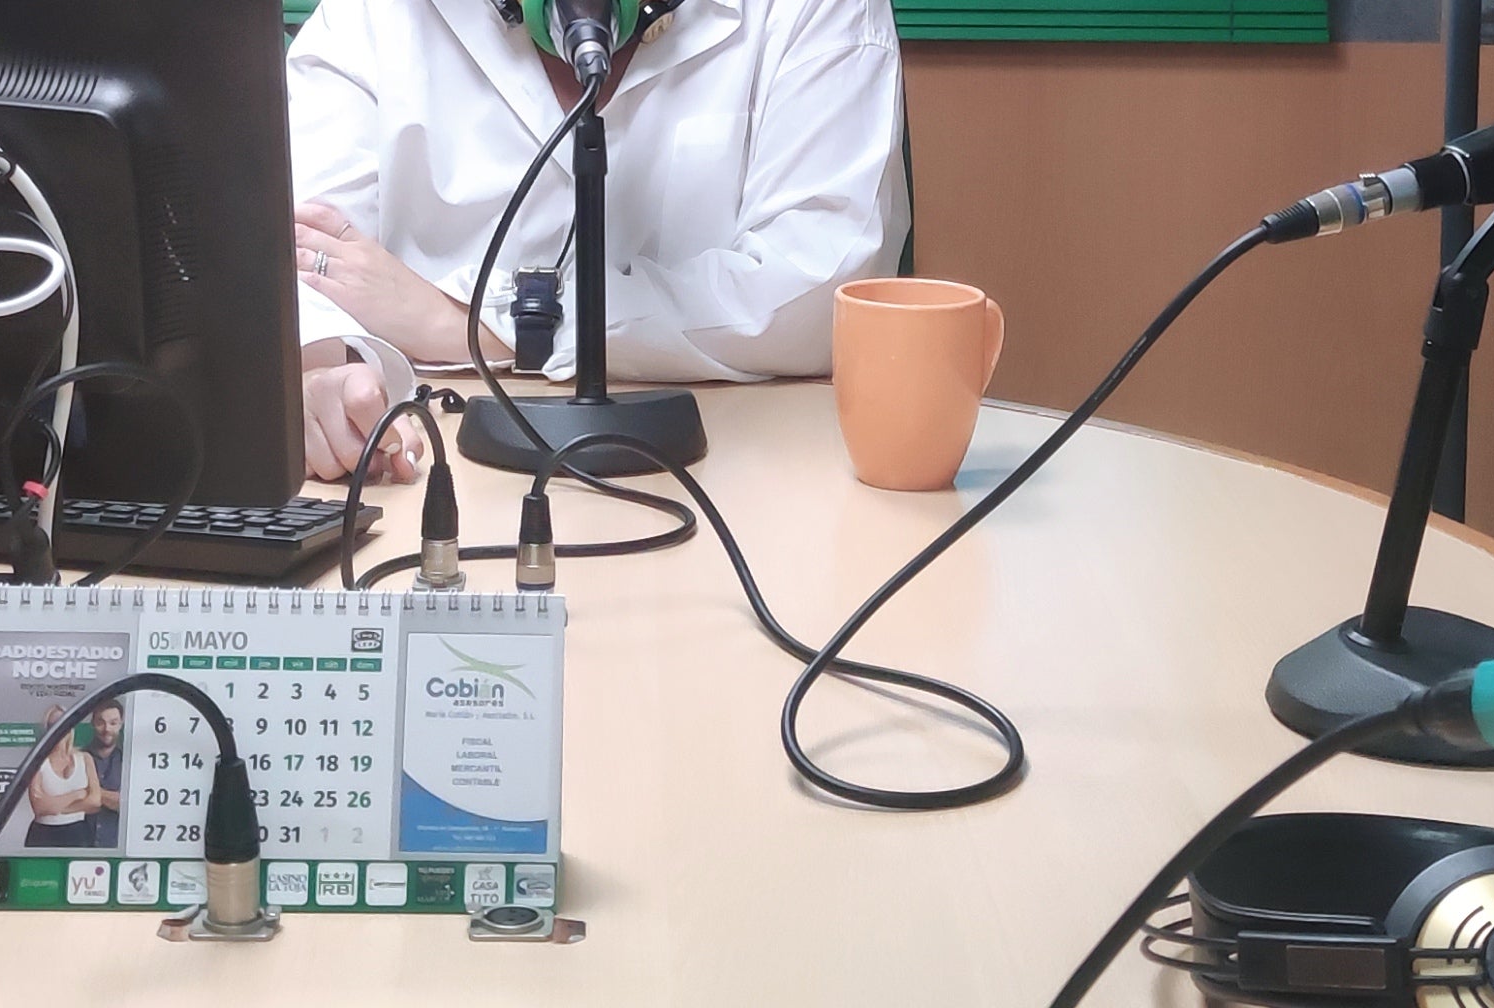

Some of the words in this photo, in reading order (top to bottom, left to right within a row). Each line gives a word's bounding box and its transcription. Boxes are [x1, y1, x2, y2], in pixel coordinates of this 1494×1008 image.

[184, 631, 249, 650] MAYO
[12, 660, 99, 680] NOCHE
[225, 683, 234, 698] 1
[257, 683, 269, 699] 2
[291, 683, 303, 700] 3
[324, 684, 337, 701] 4
[358, 684, 370, 701] 5
[426, 676, 505, 699] Cobián
[154, 716, 167, 733] 6
[189, 717, 200, 734] 7
[256, 717, 268, 734] 9
[284, 718, 307, 735] 10
[319, 719, 339, 736] 11
[352, 720, 374, 736] 12
[148, 752, 170, 769] 13
[181, 753, 204, 770] 14
[249, 754, 271, 770] 16
[284, 754, 305, 771] 17
[315, 755, 339, 772] 18
[350, 755, 373, 772] 19
[144, 788, 169, 805] 20
[179, 789, 201, 806] 21
[280, 790, 304, 807] 24
[313, 791, 338, 808] 25
[347, 791, 372, 808] 26
[143, 824, 167, 842] 27
[176, 824, 201, 842] 28
[279, 826, 301, 843] 31
[320, 827, 329, 843] 1
[352, 827, 364, 843] 2
[72, 876, 96, 896] yu
[472, 881, 499, 890] CASA
[471, 893, 500, 903] TITO
